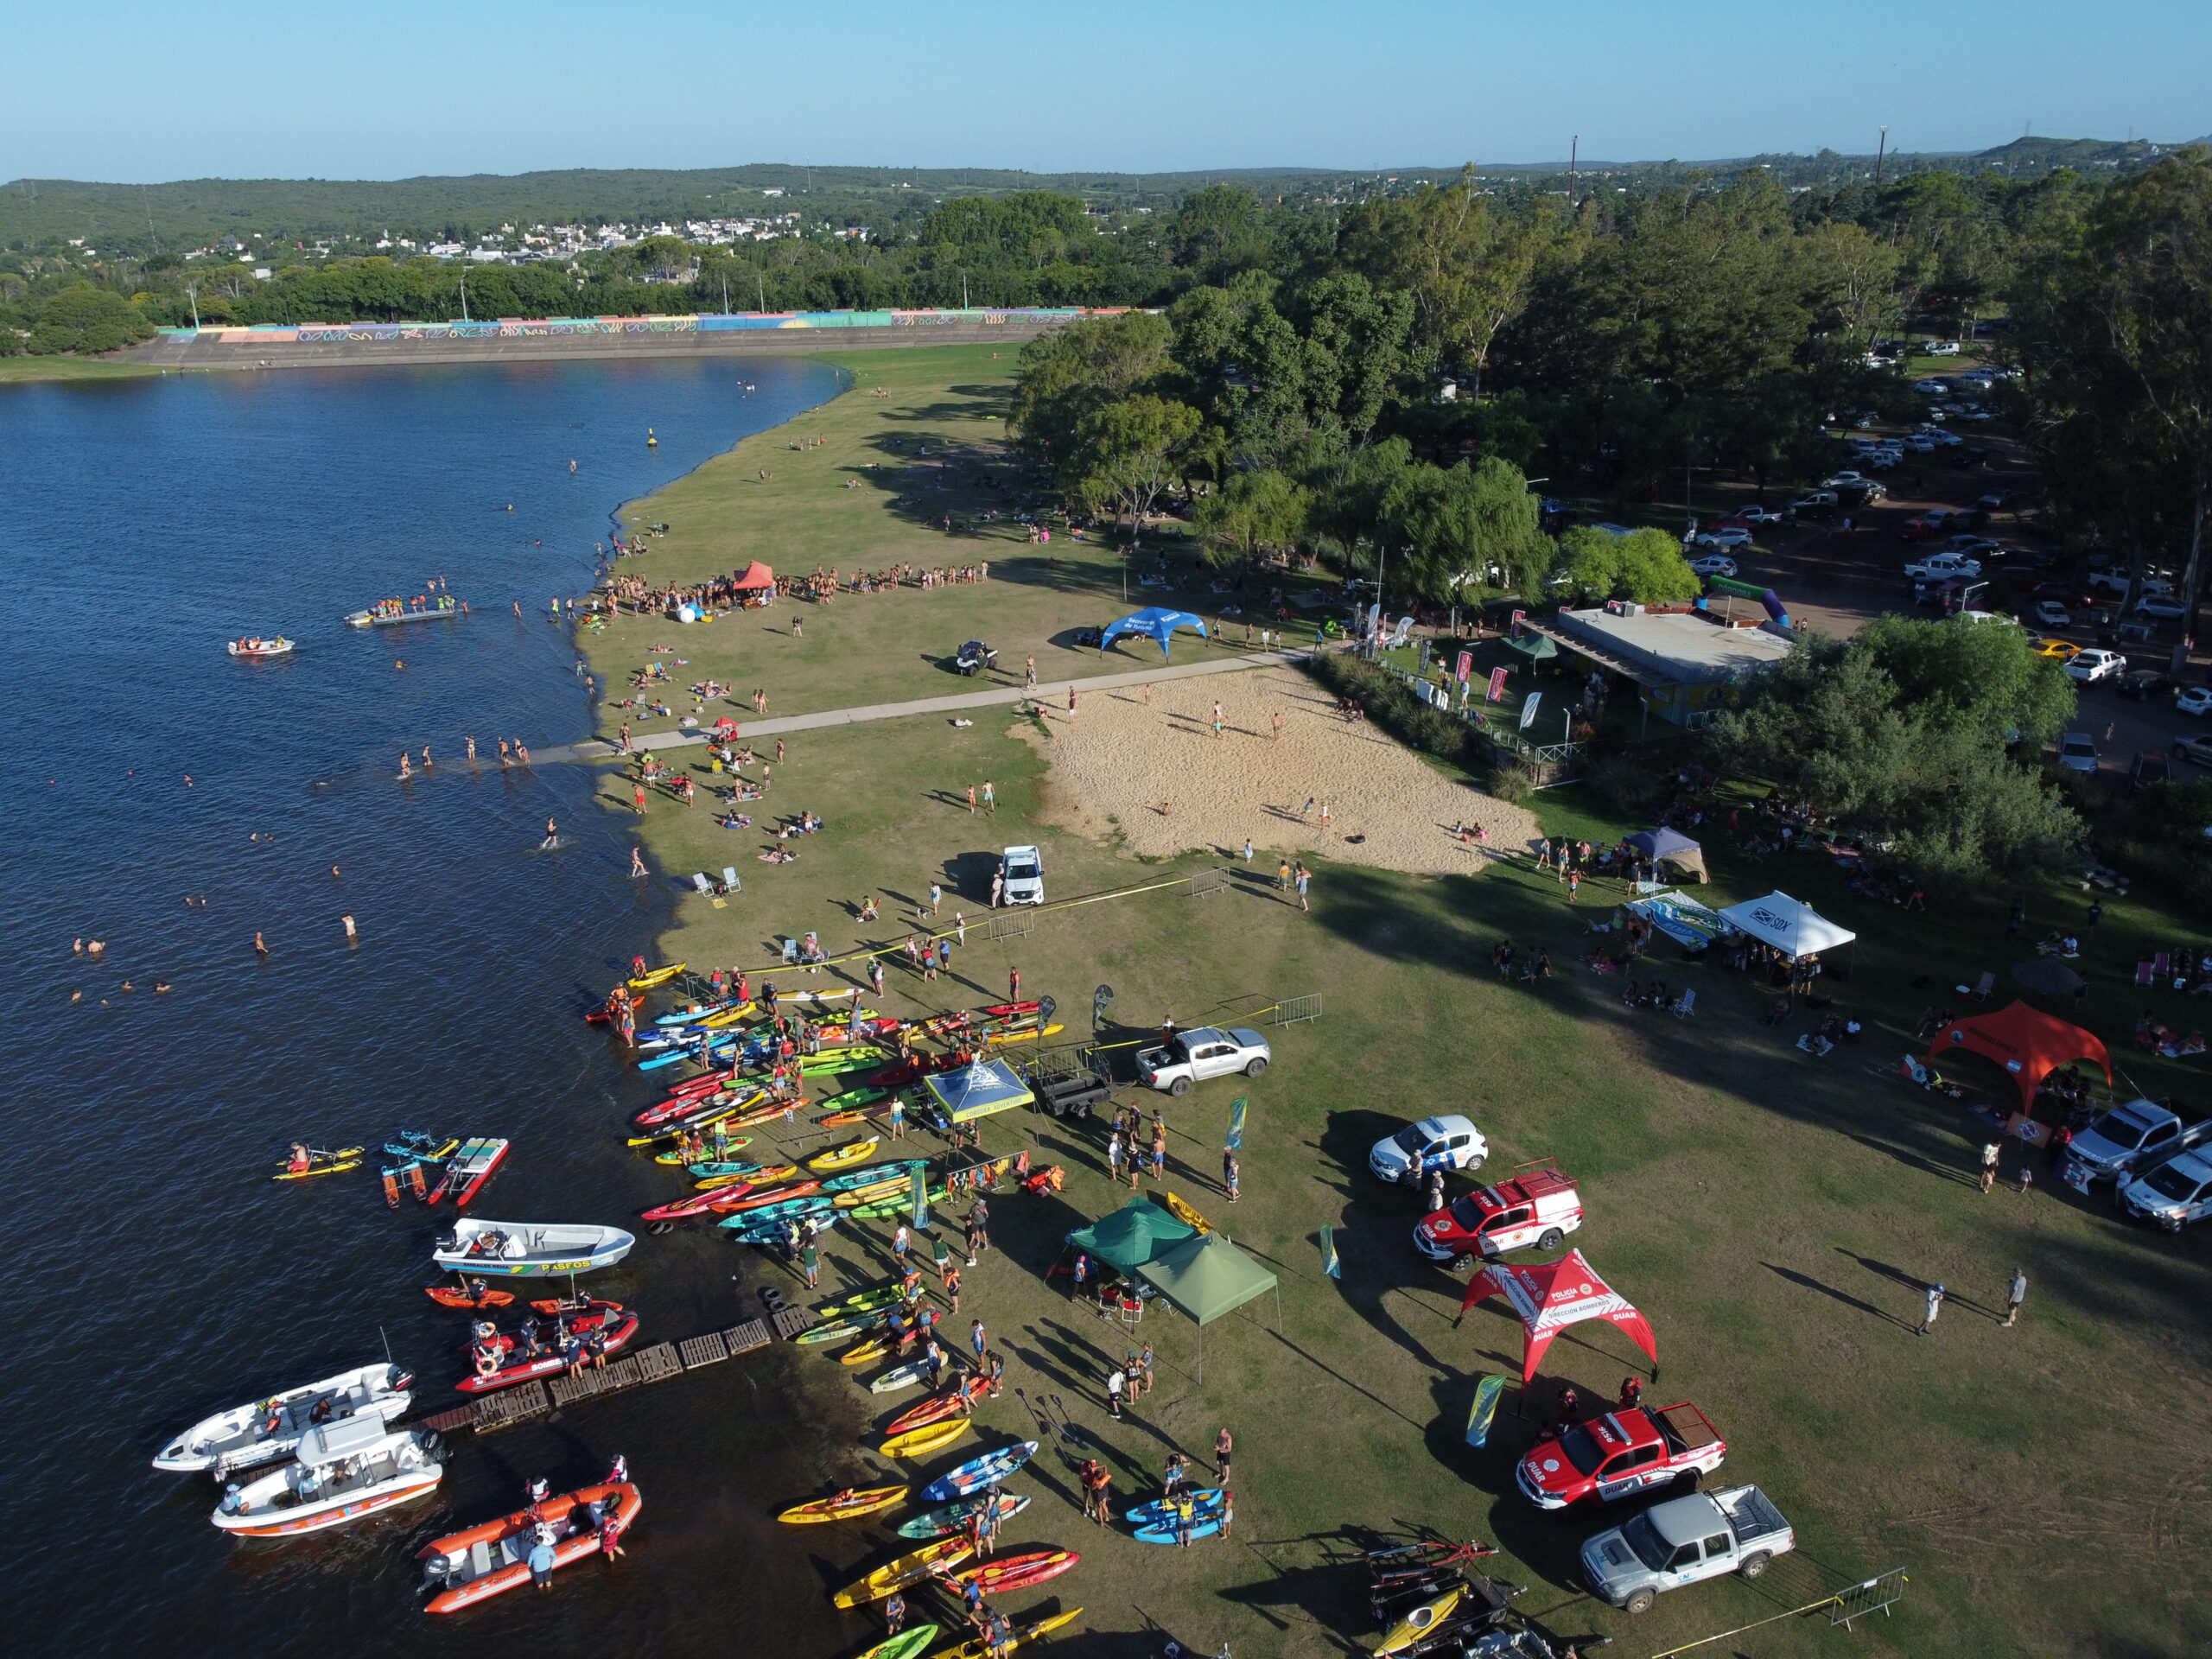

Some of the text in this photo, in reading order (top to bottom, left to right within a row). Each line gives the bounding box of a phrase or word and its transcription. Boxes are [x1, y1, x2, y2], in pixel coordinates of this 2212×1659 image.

[1770, 917, 1792, 932] SOX
[1421, 1224, 1438, 1239] DUAR
[1484, 1238, 1504, 1249] DUAR
[1482, 1272, 1498, 1290] DUAR
[1551, 1287, 1579, 1300] POLICÍA
[1548, 1300, 1610, 1319] DIRECCIÓN BOMBEROS
[1613, 1312, 1637, 1321] DUAR
[1534, 1330, 1553, 1343] DUAR
[1598, 1427, 1615, 1443] 9516
[1527, 1461, 1547, 1483] DUAR
[1605, 1481, 1630, 1495] DUAR
